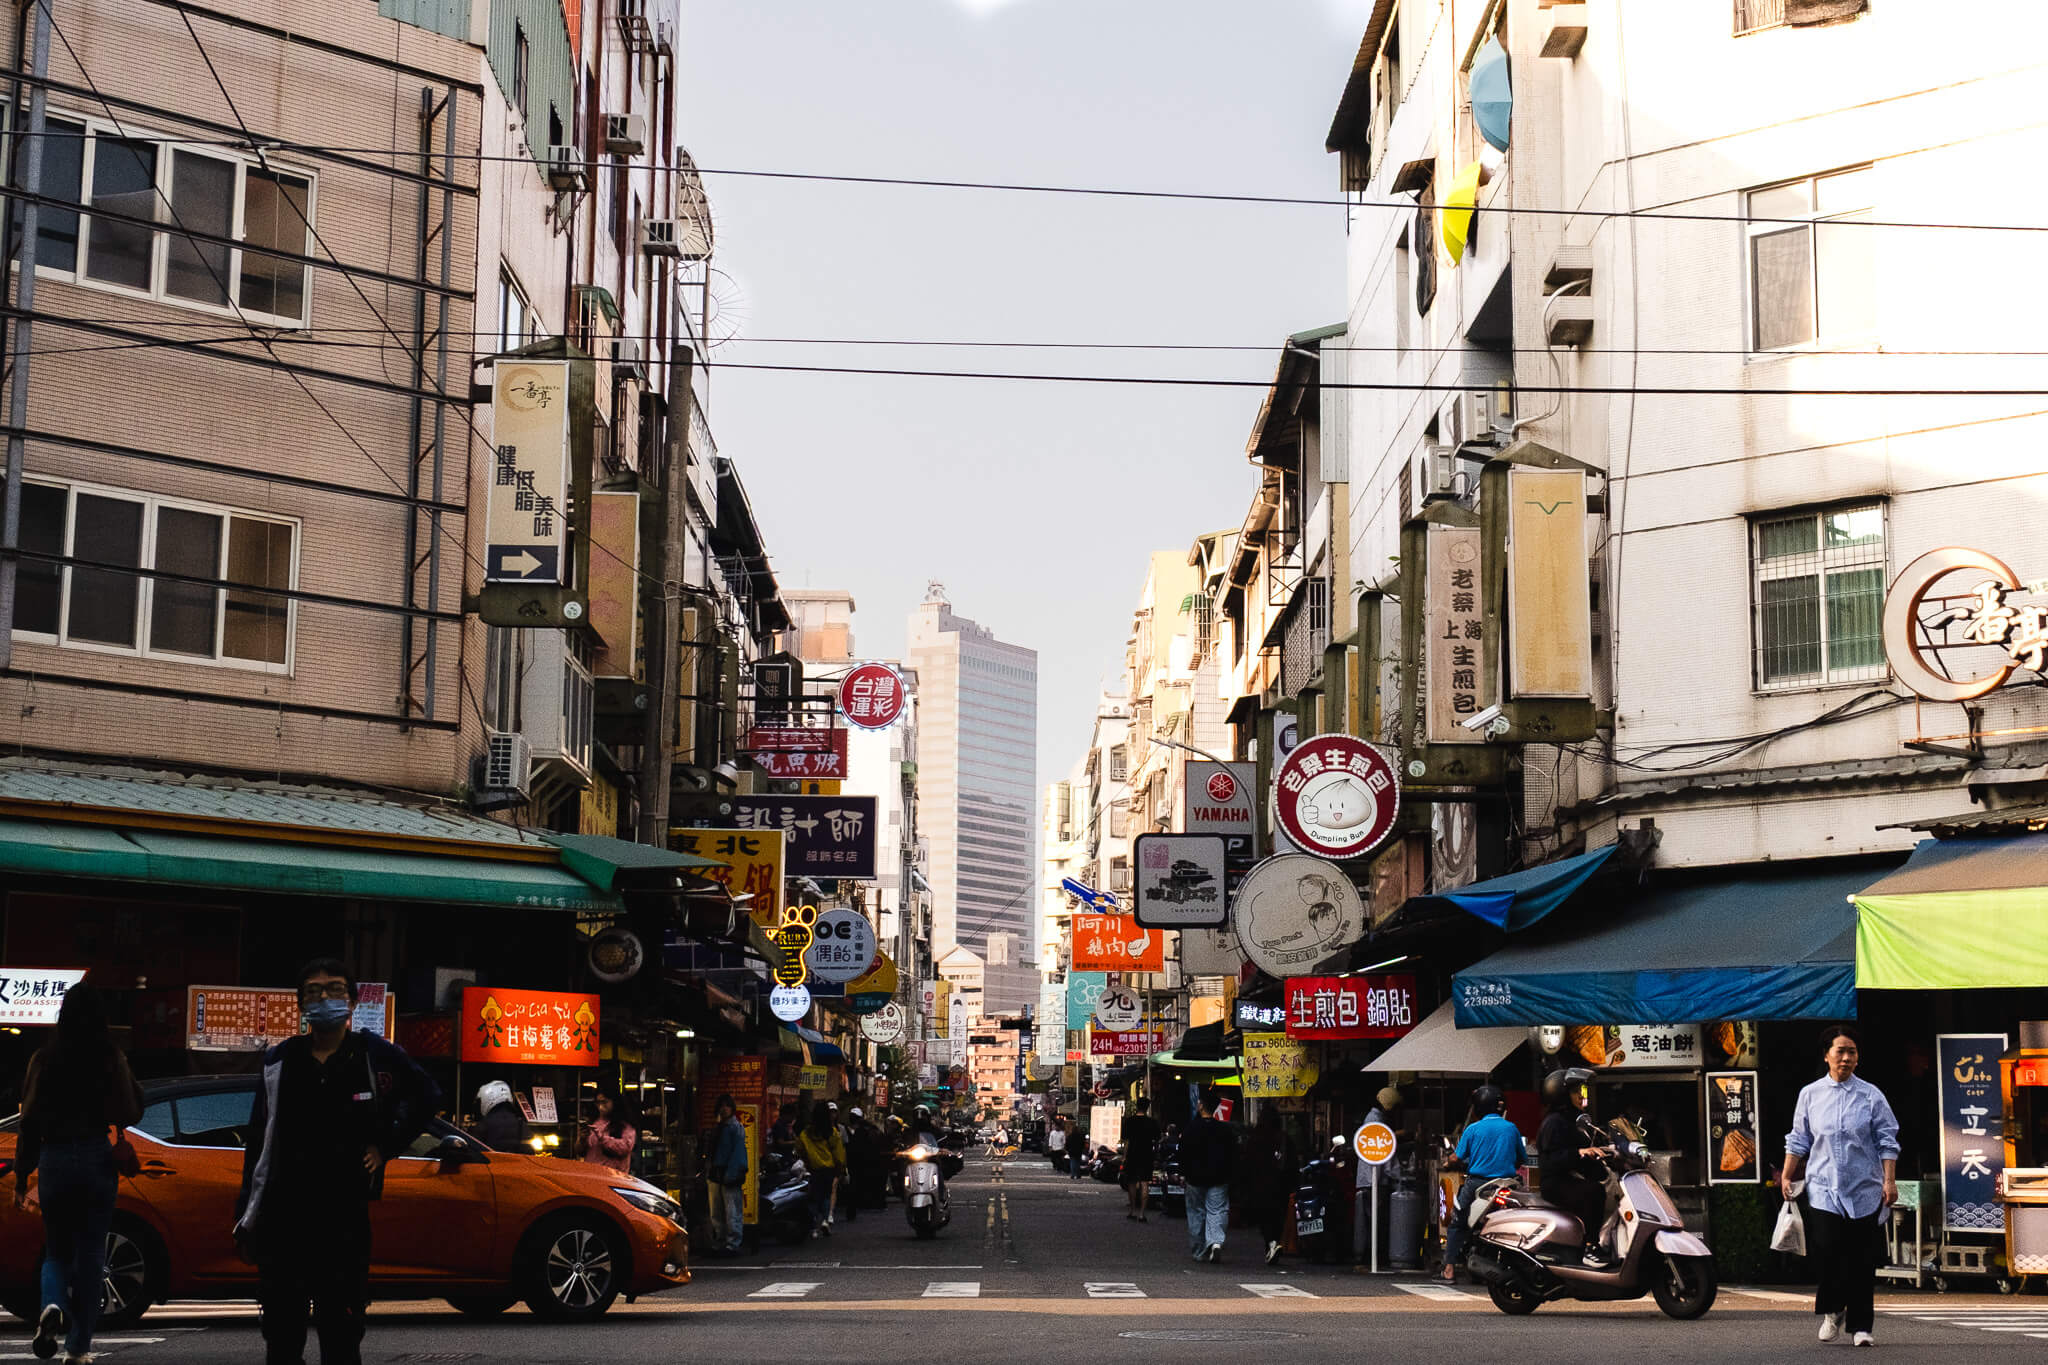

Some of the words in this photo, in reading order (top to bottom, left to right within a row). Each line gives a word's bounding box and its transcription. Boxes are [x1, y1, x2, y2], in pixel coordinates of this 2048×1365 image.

[496, 445, 517, 486] 健康
[514, 470, 535, 511] 低脂
[534, 495, 553, 537] 美味
[1451, 568, 1475, 612] 老蔡
[1442, 620, 1482, 641] 上海
[1922, 580, 2048, 672] 一番亭
[851, 675, 895, 697] 台灣
[1451, 645, 1476, 714] 生煎包
[849, 697, 894, 718] 運彩
[1281, 749, 1390, 794] 老蔡生煎包
[735, 806, 864, 842] 設計師
[1193, 807, 1249, 822] YAMAHA
[1310, 829, 1348, 843] Dumpling
[1349, 829, 1365, 840] Bun
[1077, 916, 1122, 934] 阿川
[777, 930, 808, 945] RUBY
[1086, 936, 1126, 957] 鵝肉
[1291, 987, 1359, 1028] 生煎包
[1366, 987, 1411, 1027] 鍋貼
[506, 1024, 571, 1050] 甘梅薯條
[1092, 1038, 1113, 1051] 24H
[1631, 1034, 1694, 1053] 蔥油餅
